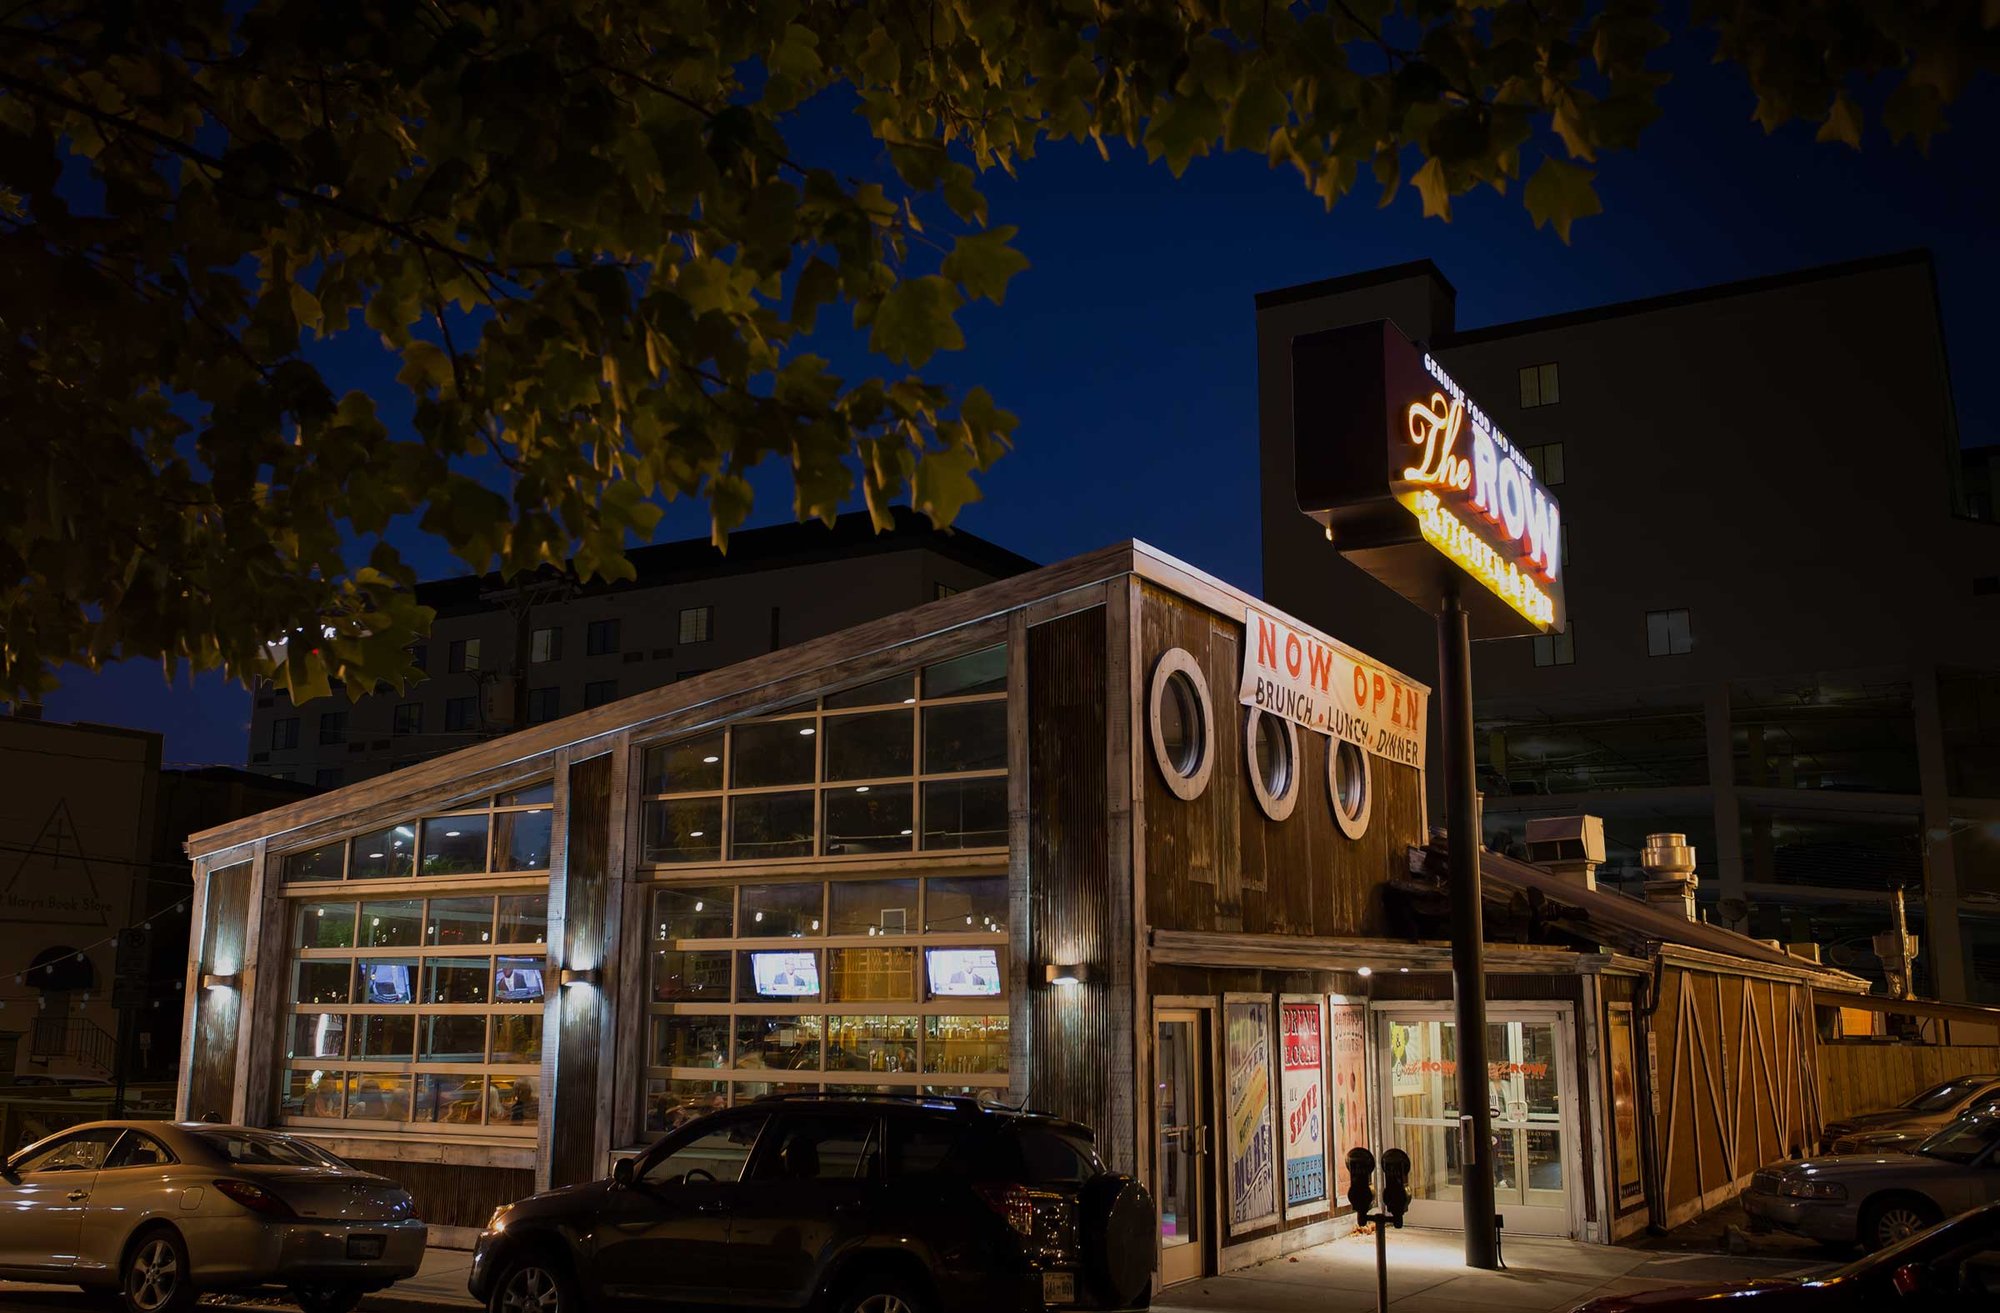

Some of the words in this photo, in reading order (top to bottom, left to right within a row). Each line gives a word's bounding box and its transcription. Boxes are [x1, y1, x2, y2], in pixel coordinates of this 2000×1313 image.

[1424, 353, 1466, 408] GENUINE
[1467, 399, 1491, 434] FOOD
[1492, 426, 1509, 454] AND
[1509, 444, 1534, 480] DRINK
[1403, 391, 1471, 491] The
[1470, 419, 1560, 580] ROW
[1257, 616, 1333, 692] NOW
[1353, 665, 1419, 732] OPEN
[1255, 676, 1314, 726] BRUNCH
[1326, 705, 1370, 746] LUNCH
[1376, 728, 1419, 767] DINNER
[82, 897, 113, 912] Store
[1283, 1008, 1318, 1036] DRINK
[1283, 1045, 1319, 1066] LOCAL
[1421, 1060, 1457, 1078] ROW
[1510, 1062, 1548, 1077] ROW
[1289, 1083, 1318, 1144] SERVE
[1234, 1124, 1272, 1201] MORE
[1287, 1171, 1323, 1200] DRAFTS
